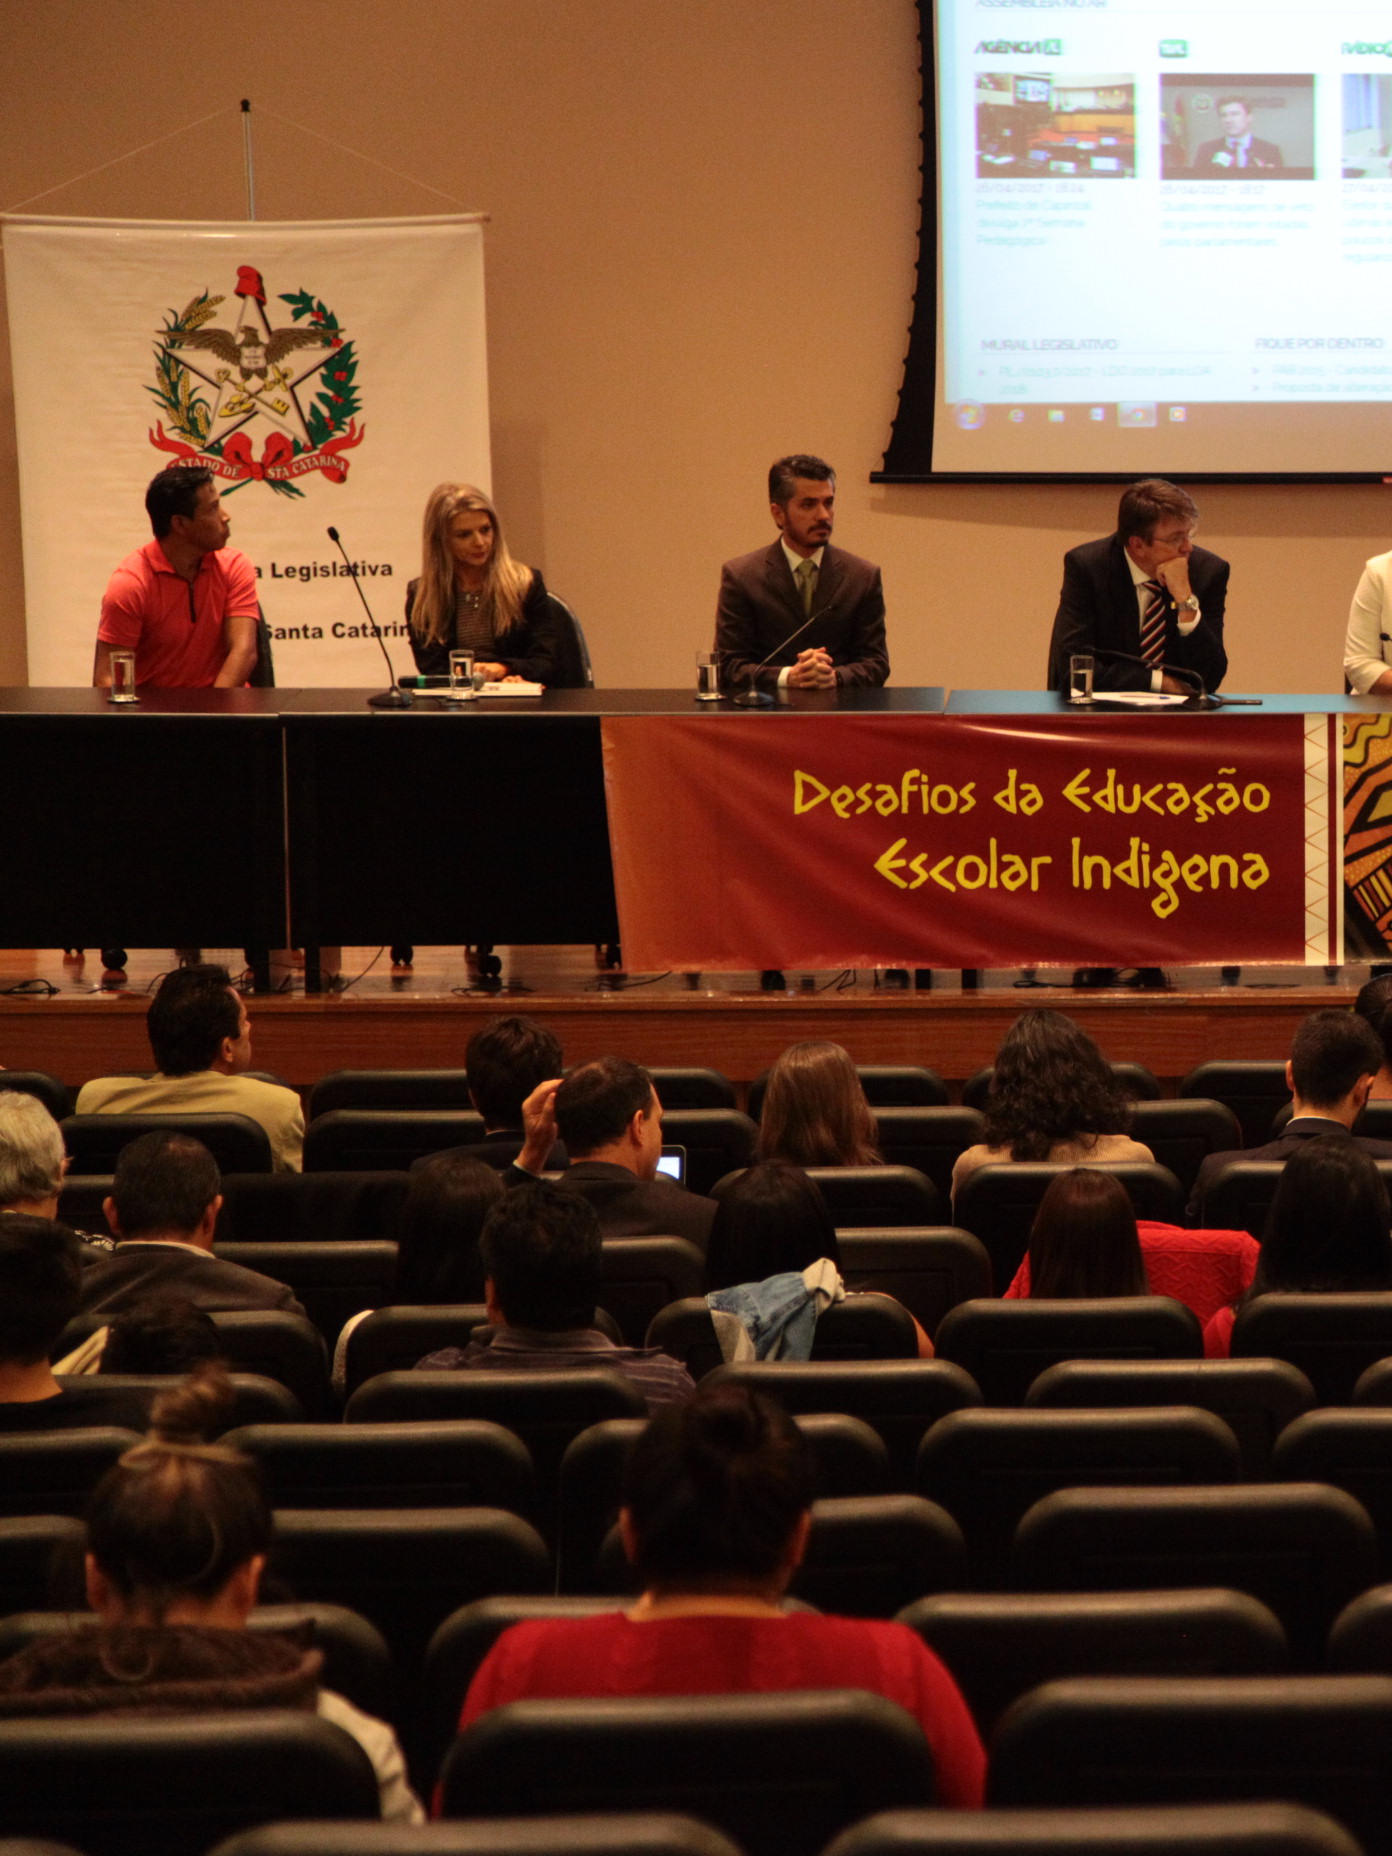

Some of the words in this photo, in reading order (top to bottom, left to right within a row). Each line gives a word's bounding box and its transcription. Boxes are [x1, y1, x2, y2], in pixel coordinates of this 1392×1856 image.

[980, 338, 1030, 350] MURAL
[1033, 338, 1119, 351] LEGISLATIVO
[1297, 337, 1326, 350] POR
[1328, 337, 1385, 349] DENTRO
[291, 453, 347, 474] CATARINA
[271, 560, 394, 583] Legislativa
[332, 621, 410, 638] Catarin
[793, 768, 977, 819] Desafios
[993, 768, 1044, 816] da
[1062, 767, 1271, 823] Educação
[874, 837, 1053, 893] Escolar
